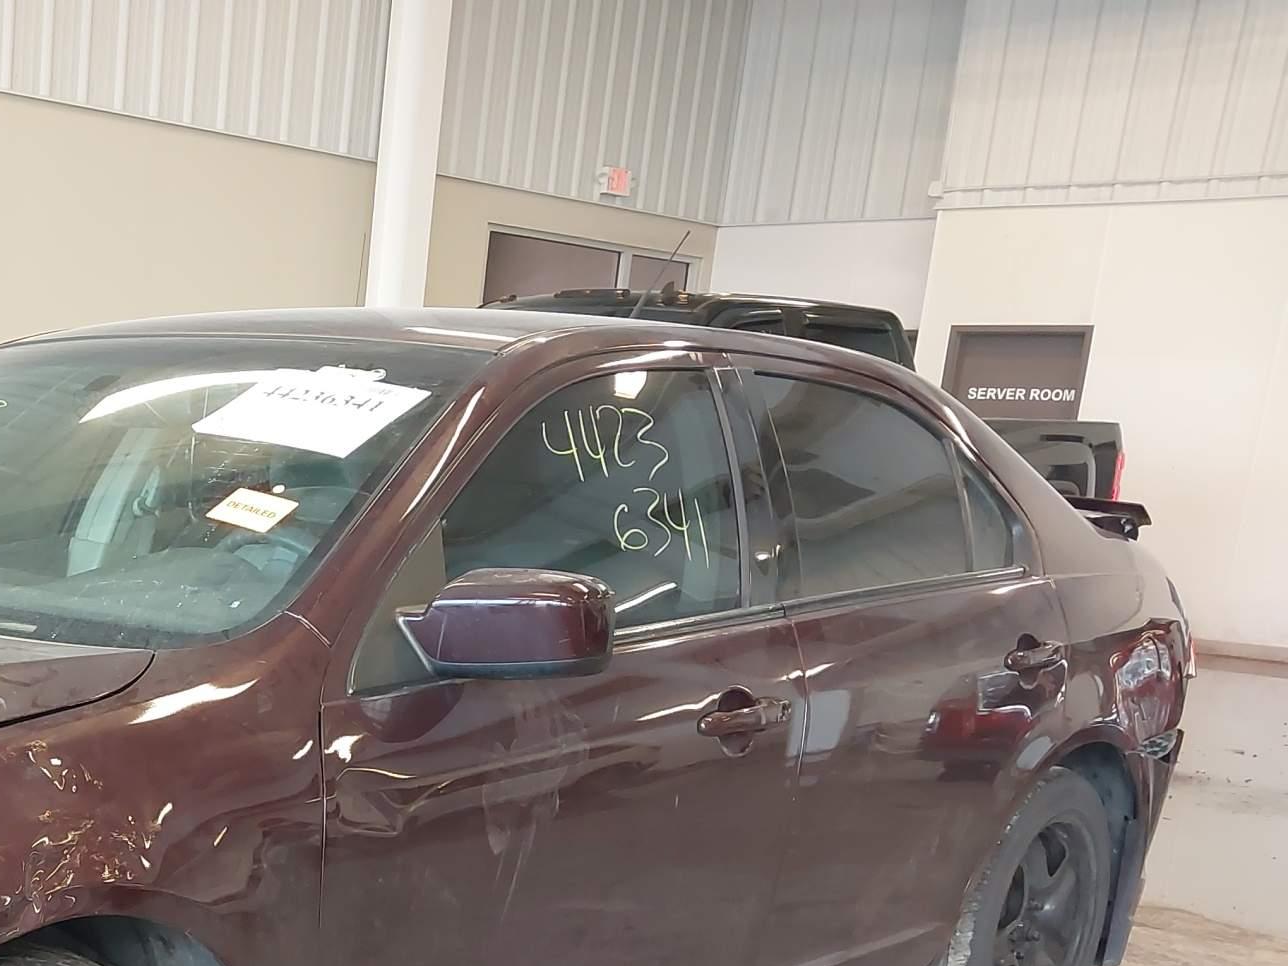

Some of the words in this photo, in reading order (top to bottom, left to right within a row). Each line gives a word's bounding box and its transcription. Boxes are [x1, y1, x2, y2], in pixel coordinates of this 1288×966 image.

[263, 385, 386, 412] 44236341
[967, 387, 1026, 401] SERVER
[1029, 388, 1076, 402] ROOM
[540, 404, 670, 483] 4423
[226, 499, 276, 519] DETAILED
[612, 486, 710, 569] 6341
